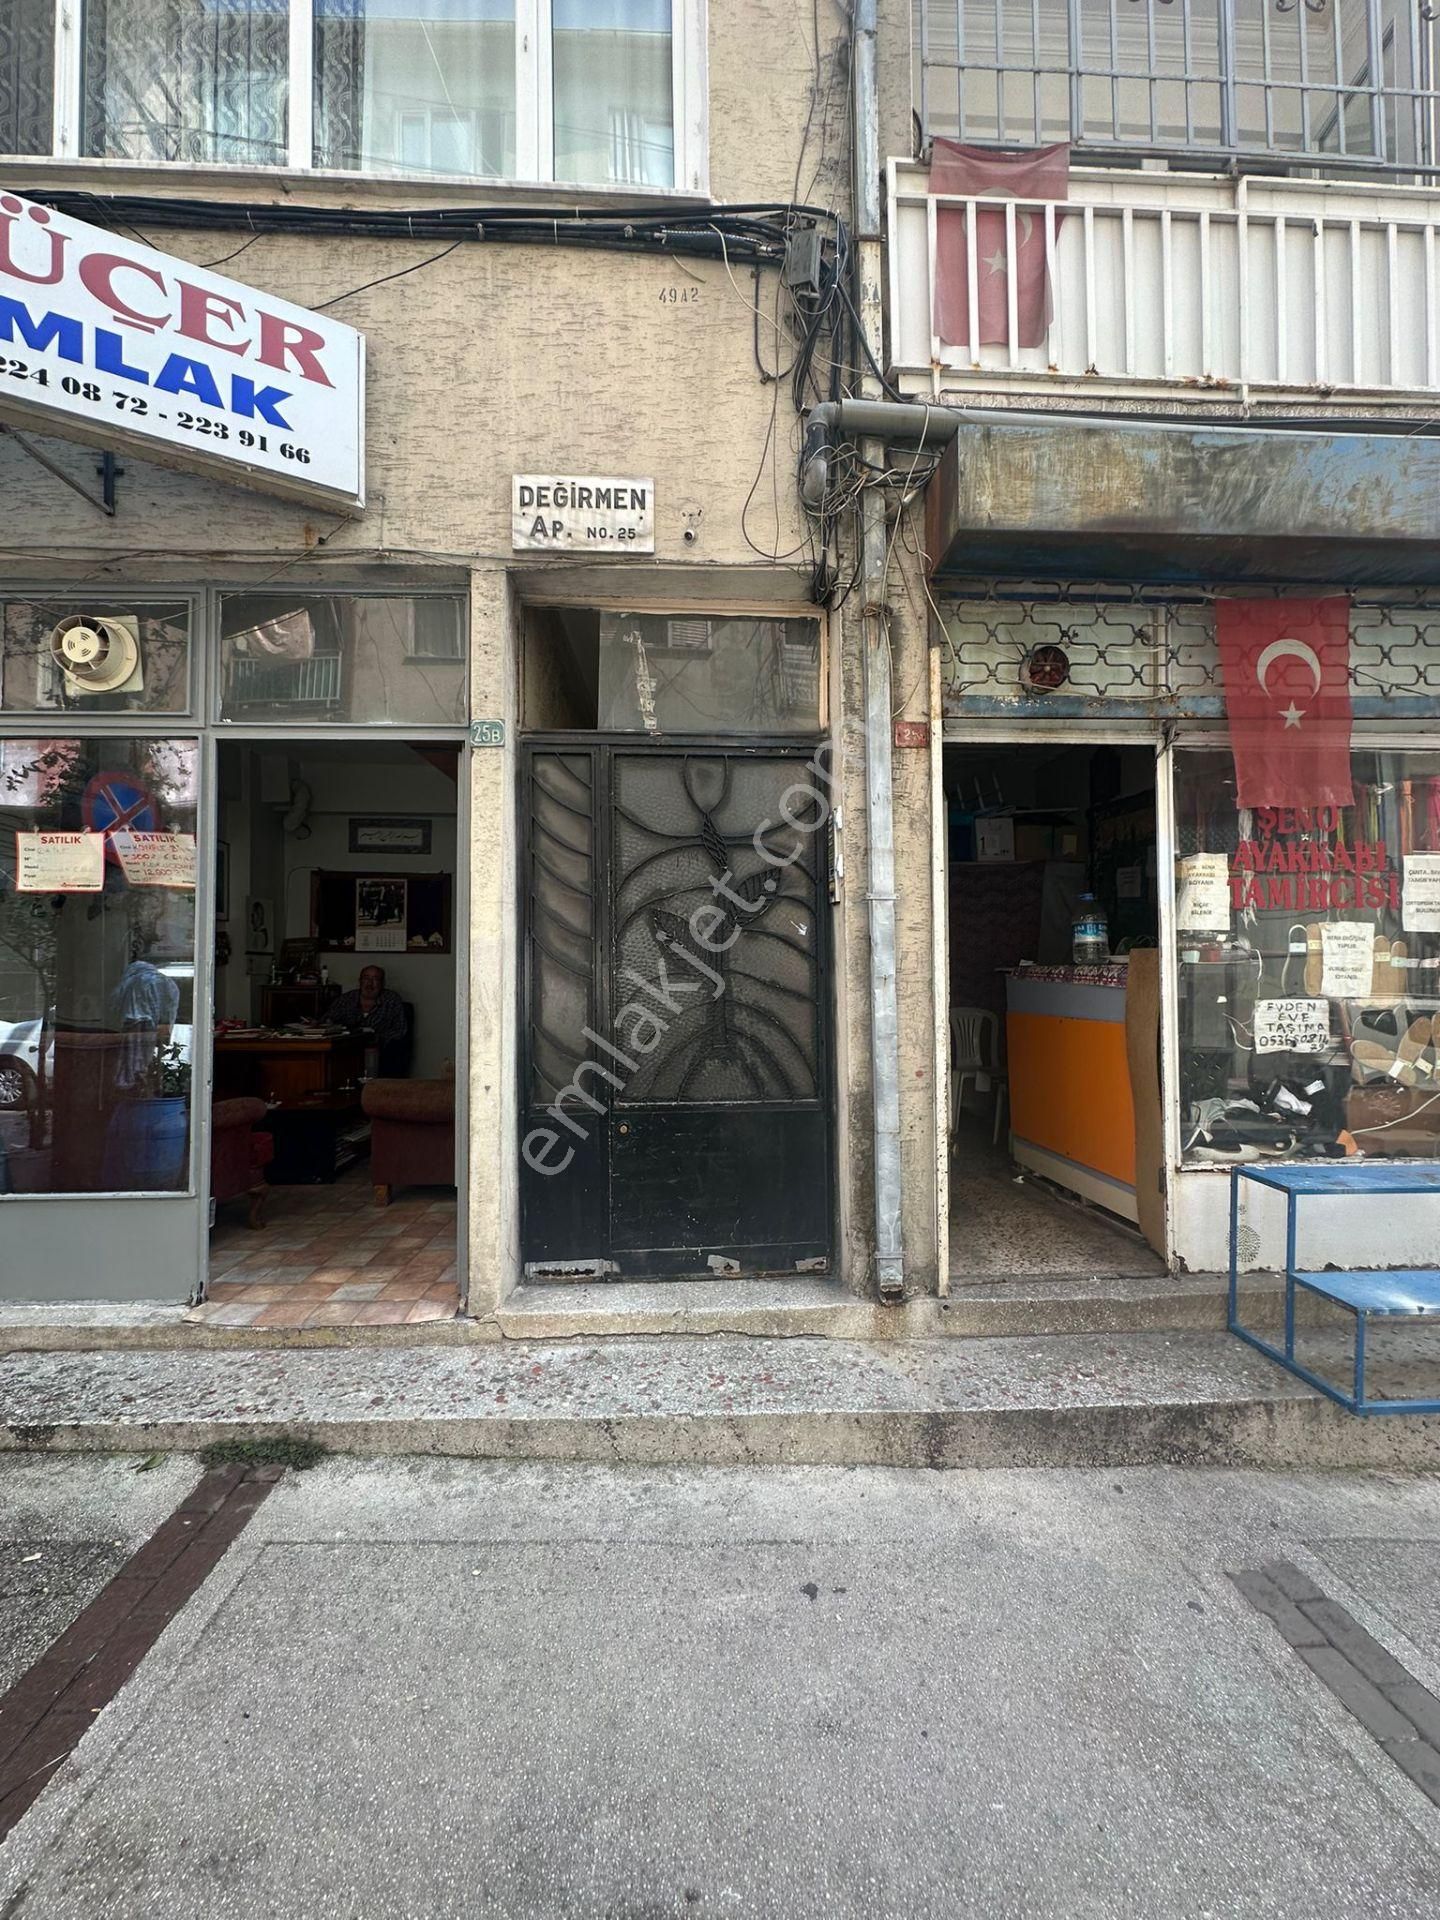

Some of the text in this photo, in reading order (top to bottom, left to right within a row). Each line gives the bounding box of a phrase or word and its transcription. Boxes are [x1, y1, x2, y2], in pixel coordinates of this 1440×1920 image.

[0, 196, 337, 390] ÜÇER
[658, 287, 699, 303] 49A2
[0, 295, 295, 432] MLAK
[61, 376, 102, 402] 08
[112, 390, 149, 416] 72
[177, 411, 229, 440] 223
[238, 429, 269, 453] 91
[280, 443, 311, 464] 66
[519, 482, 646, 510] DEĞİRMEN
[530, 515, 572, 538] AP.
[473, 724, 501, 742] 25B
[41, 836, 82, 844] SATILIK
[134, 834, 177, 843] SATILIK
[1278, 1013, 1310, 1022] EVE
[1264, 1022, 1326, 1034] TAŞIMA
